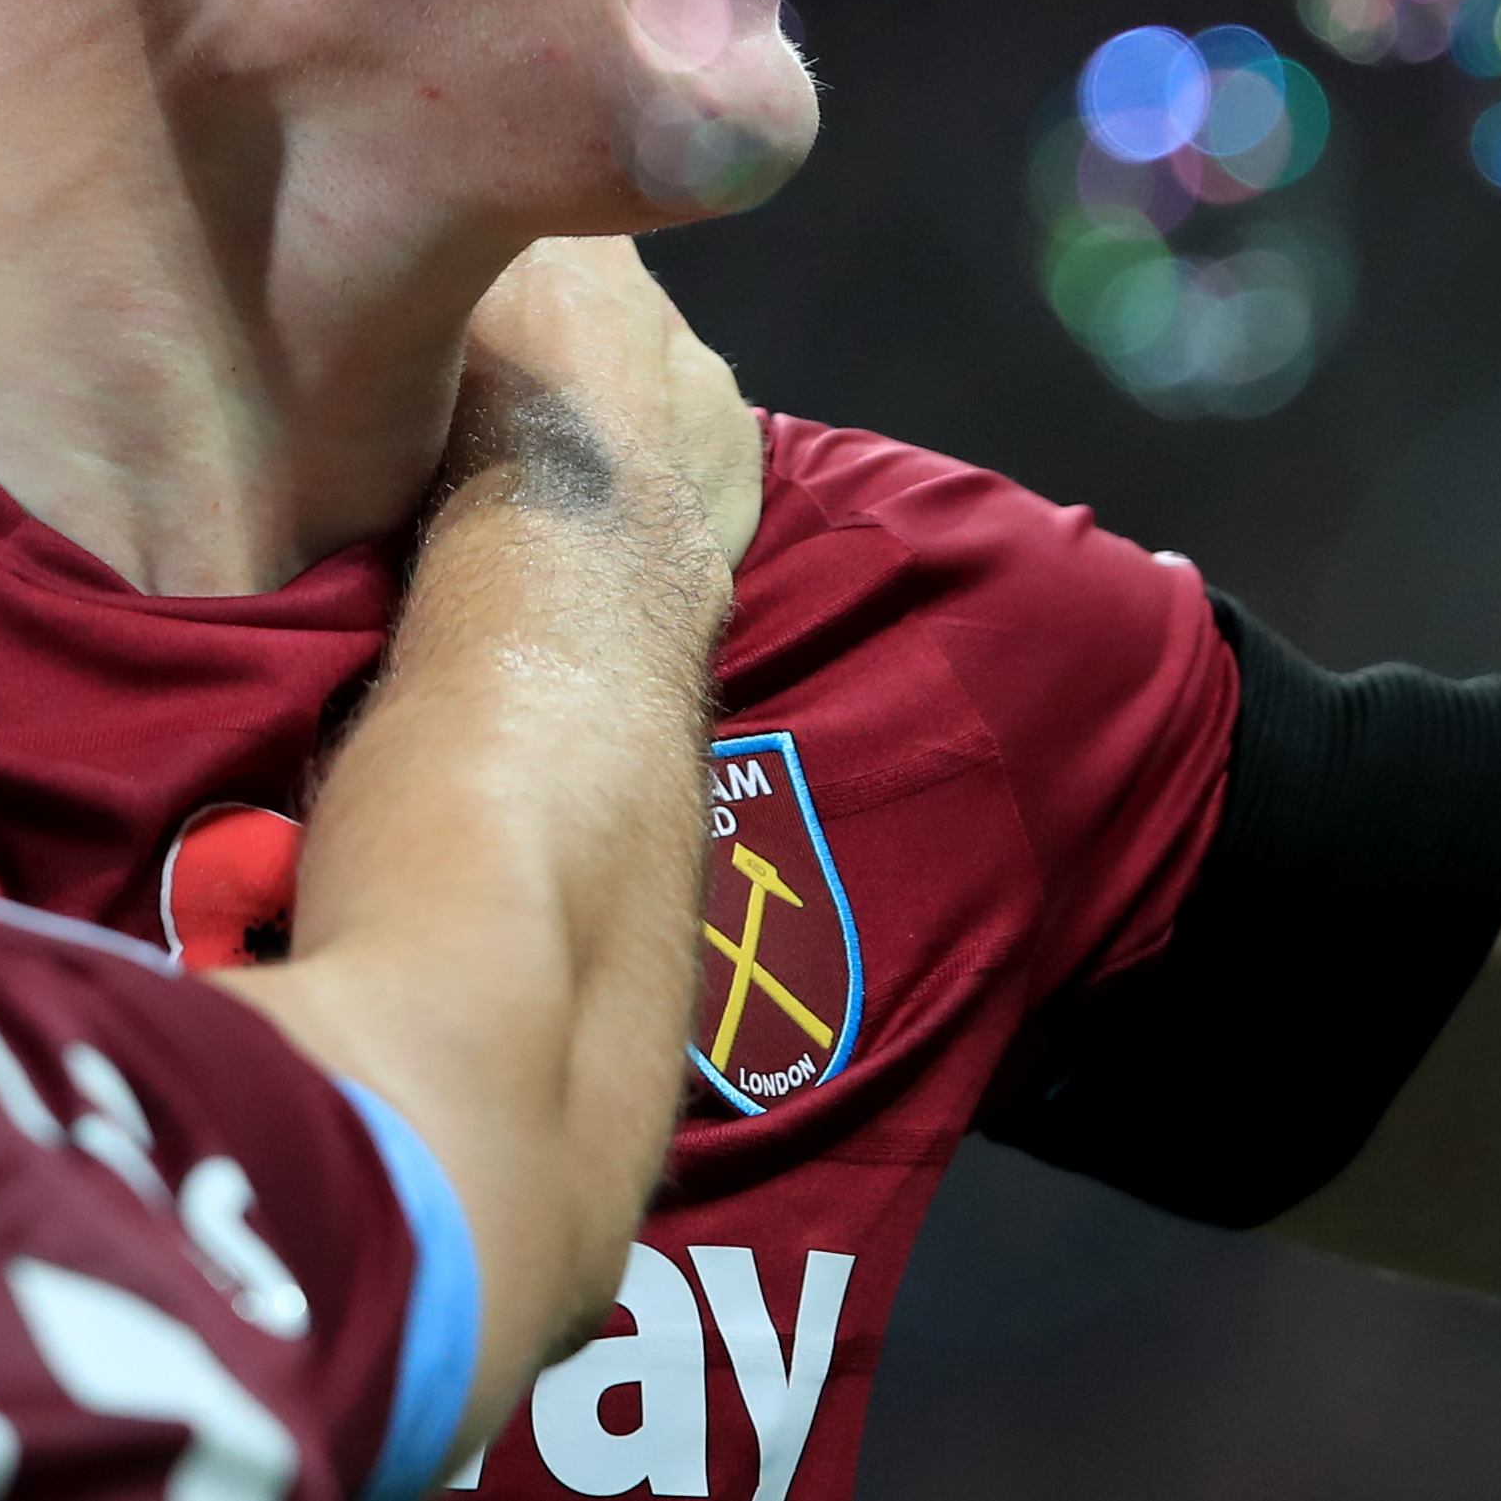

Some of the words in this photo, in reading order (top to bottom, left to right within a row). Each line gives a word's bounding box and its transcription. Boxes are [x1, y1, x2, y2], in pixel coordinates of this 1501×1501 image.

[707, 759, 774, 802] AM
[739, 1052, 817, 1097] LONDON
[444, 1241, 857, 1501] ay
